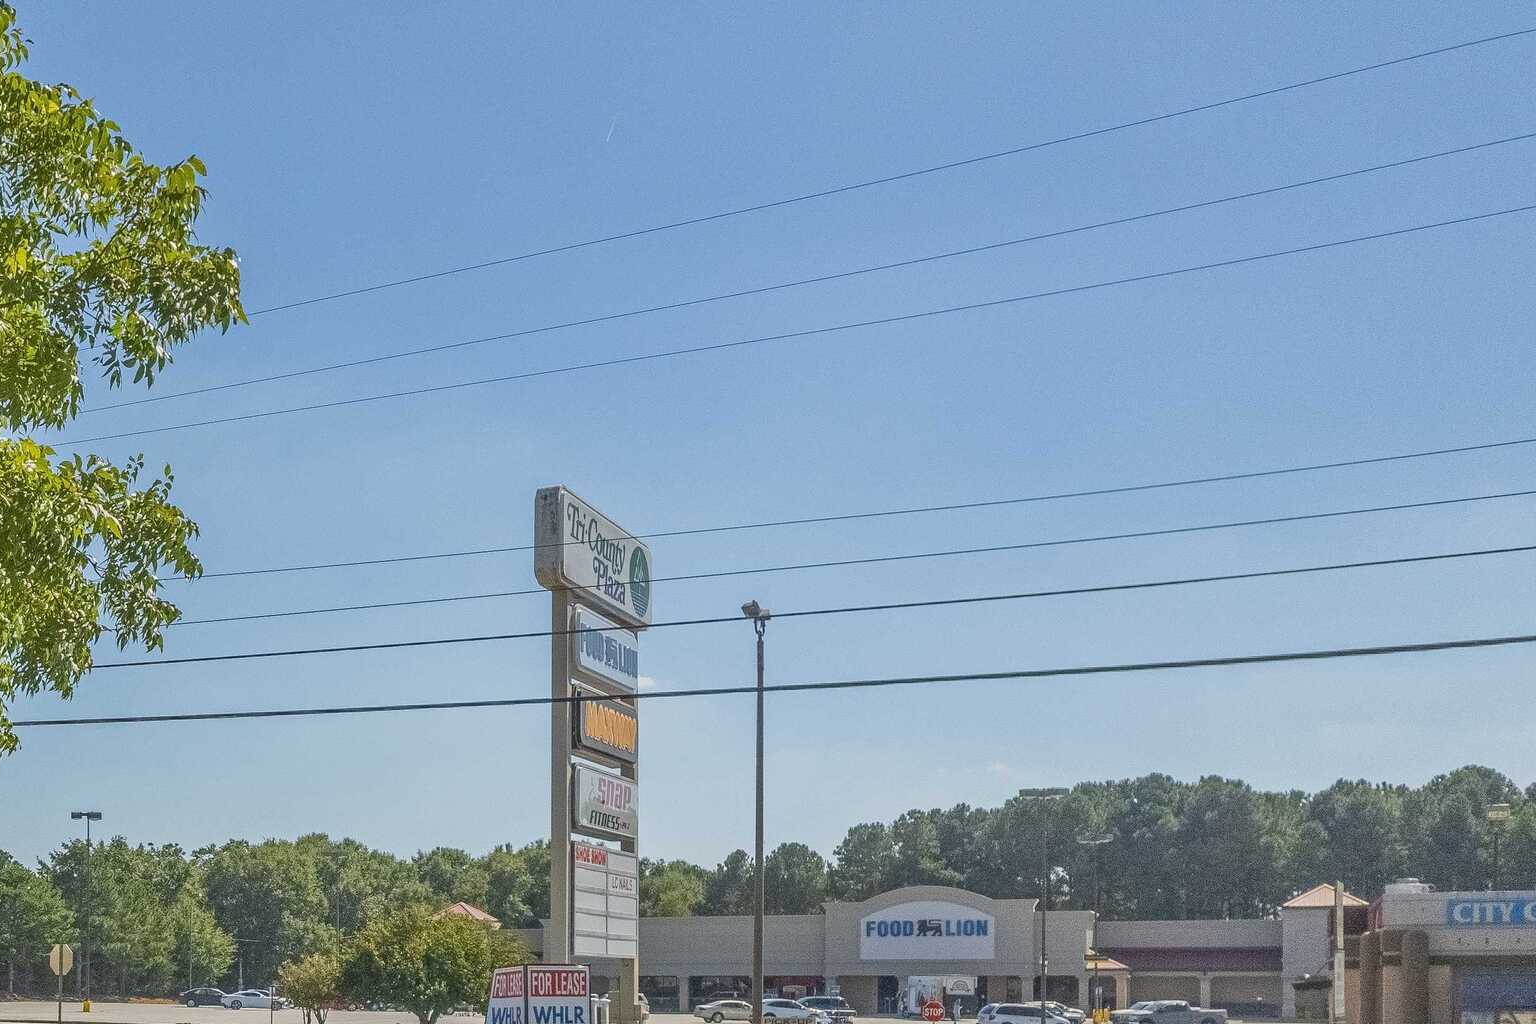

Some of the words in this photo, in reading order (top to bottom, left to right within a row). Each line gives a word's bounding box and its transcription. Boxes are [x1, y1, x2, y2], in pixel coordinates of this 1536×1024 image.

[592, 556, 625, 605] Plaza
[1453, 902, 1515, 922] CITY
[866, 920, 914, 937] FOOD
[945, 920, 988, 936] LION
[495, 975, 507, 997] FOR
[507, 972, 522, 996] LEASE
[532, 972, 553, 995] FOR
[555, 972, 586, 995] LEASE
[492, 1007, 522, 1024] WHLR
[533, 1006, 585, 1024] WHLR
[924, 1008, 943, 1017] STOP
